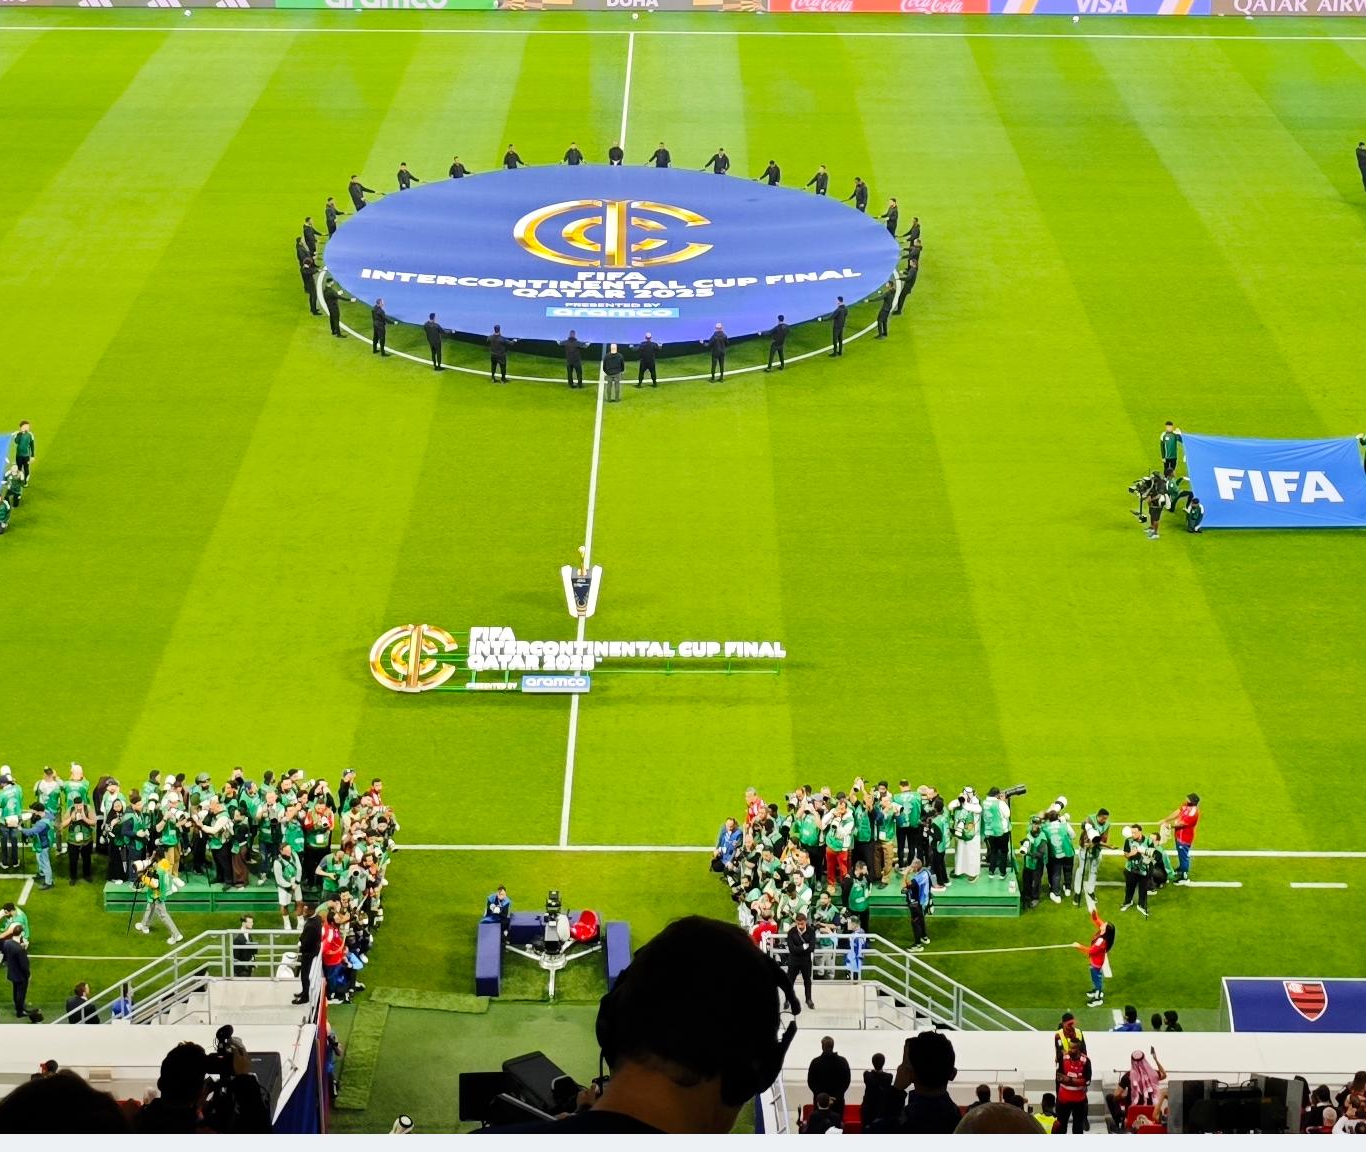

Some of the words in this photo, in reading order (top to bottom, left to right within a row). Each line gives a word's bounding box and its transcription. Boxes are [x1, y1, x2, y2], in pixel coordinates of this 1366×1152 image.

[361, 268, 687, 290] INTERCONTINENTAL
[692, 277, 758, 288] CUP
[765, 268, 862, 285] FINAL
[577, 271, 648, 281] FIFA
[512, 288, 627, 299] QATAR
[633, 288, 714, 299] 2025
[552, 308, 674, 318] aramco
[1213, 467, 1344, 503] FIFA
[470, 626, 516, 641] FIFA
[468, 640, 676, 657] INTERCONTINENTAL
[678, 641, 721, 658] CUP
[724, 641, 786, 658] FINAL
[467, 654, 541, 671] QATAR
[525, 677, 587, 688] aramco
